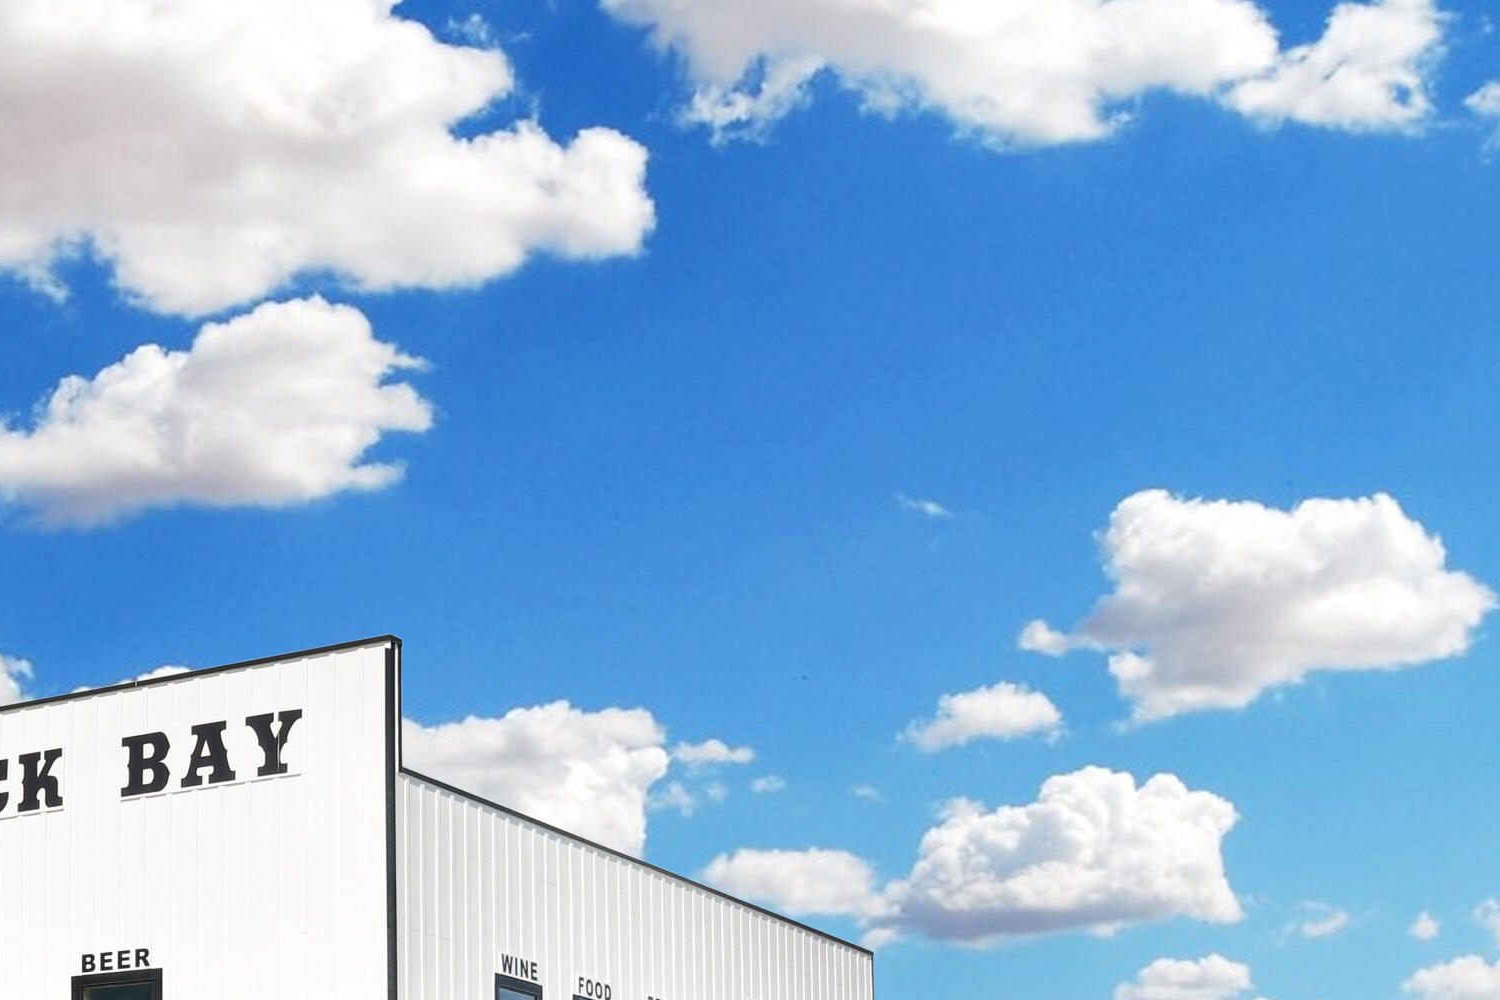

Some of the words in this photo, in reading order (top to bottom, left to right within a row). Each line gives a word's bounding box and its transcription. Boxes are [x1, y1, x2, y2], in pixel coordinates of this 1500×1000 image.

[121, 709, 303, 797] BAY
[81, 948, 151, 973] BEER
[501, 953, 538, 981] WINE
[578, 976, 612, 1000] FOOD
